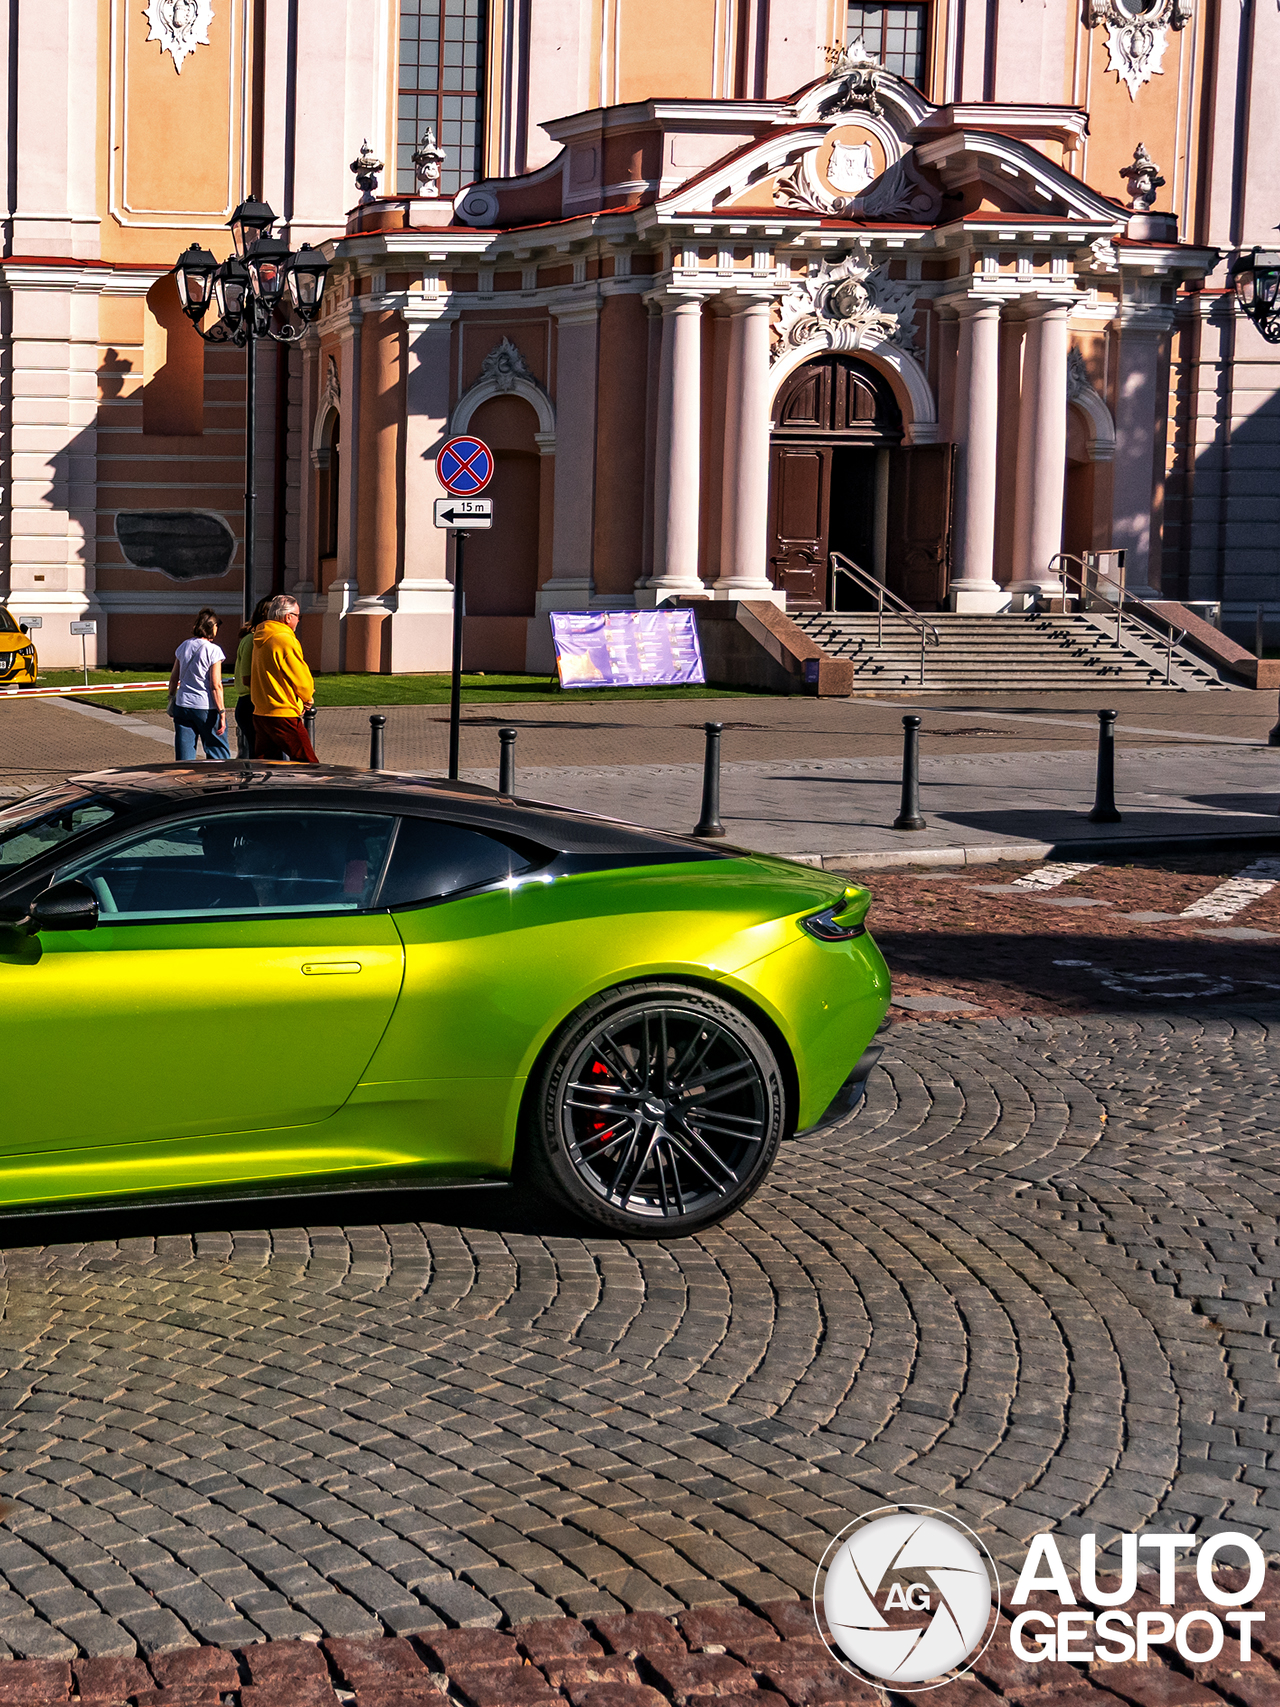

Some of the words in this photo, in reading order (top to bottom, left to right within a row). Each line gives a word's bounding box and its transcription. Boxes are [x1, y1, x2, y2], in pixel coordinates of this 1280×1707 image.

[461, 502, 472, 512] 15
[475, 504, 484, 512] m
[546, 1063, 564, 1133] MICHELIN
[763, 1094, 780, 1163] MICHELIN
